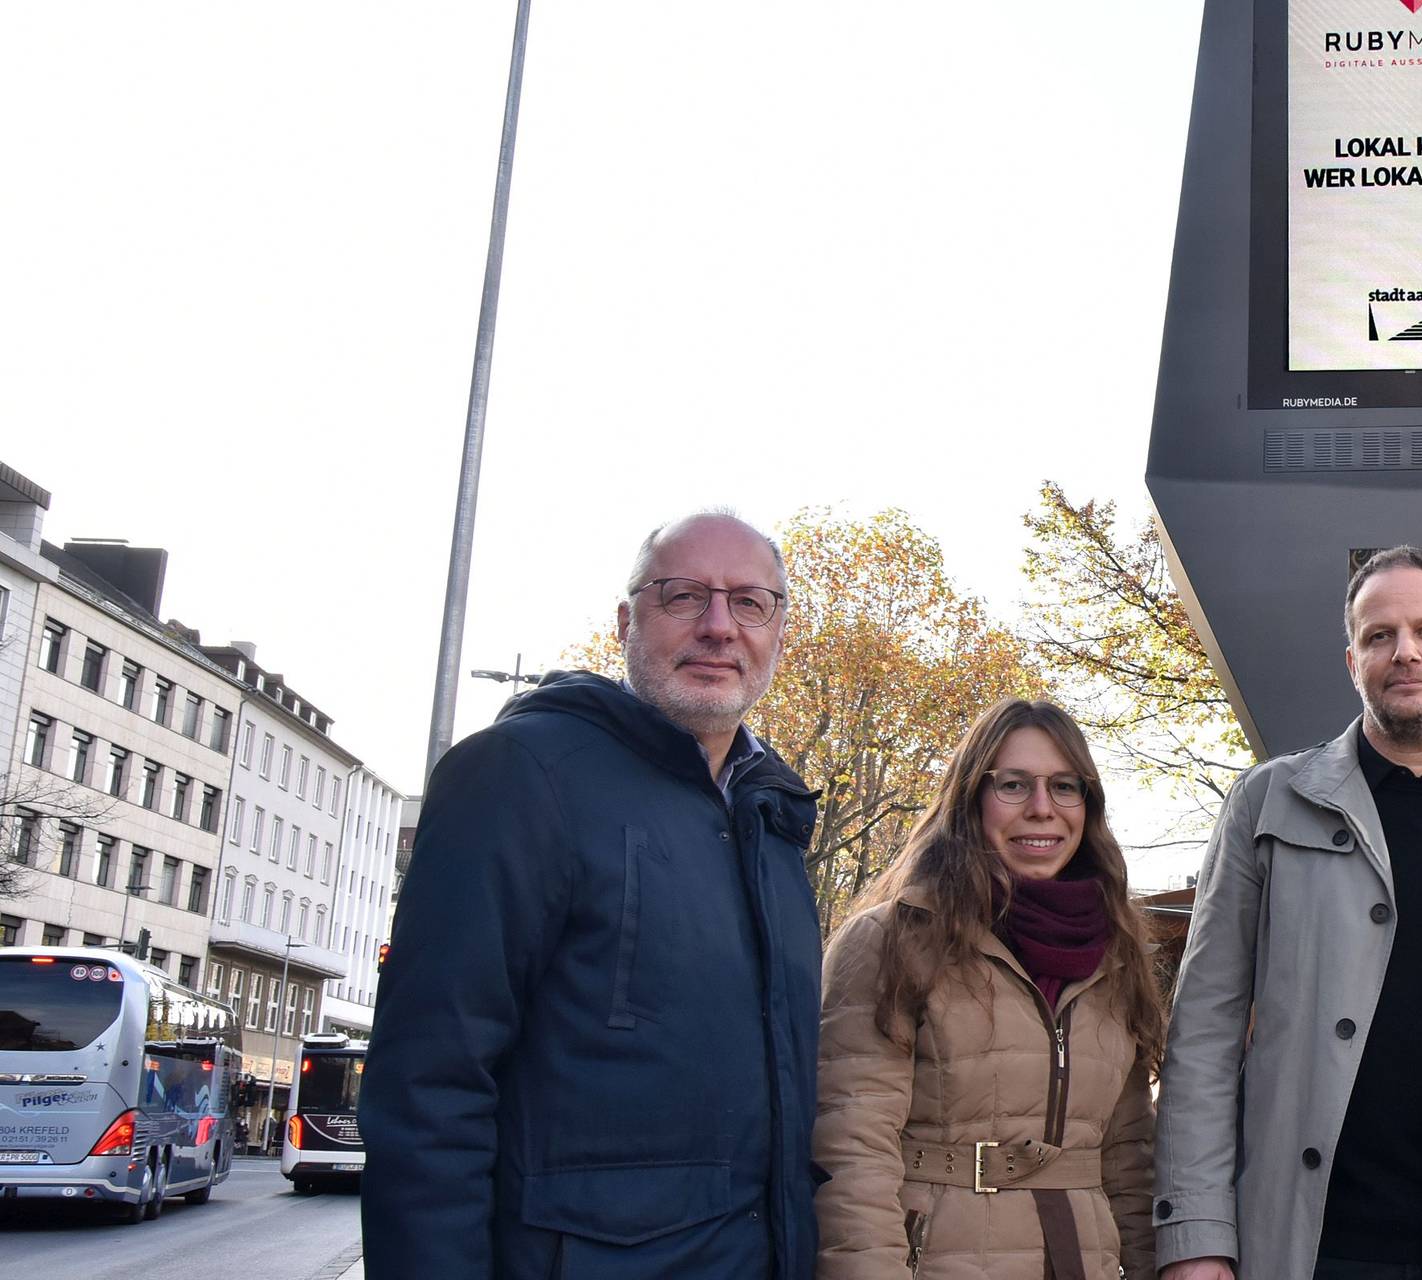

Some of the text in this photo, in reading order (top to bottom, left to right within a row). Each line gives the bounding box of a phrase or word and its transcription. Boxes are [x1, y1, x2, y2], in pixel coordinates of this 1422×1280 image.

[1325, 60, 1384, 68] DIGITALE
[1335, 138, 1411, 158] LOKAL
[1304, 168, 1355, 188] WER
[1368, 287, 1405, 302] stadt
[1282, 397, 1358, 407] RUBYMEDIA.DE
[22, 1092, 67, 1107] Pilger
[19, 1126, 70, 1135] KREFELD
